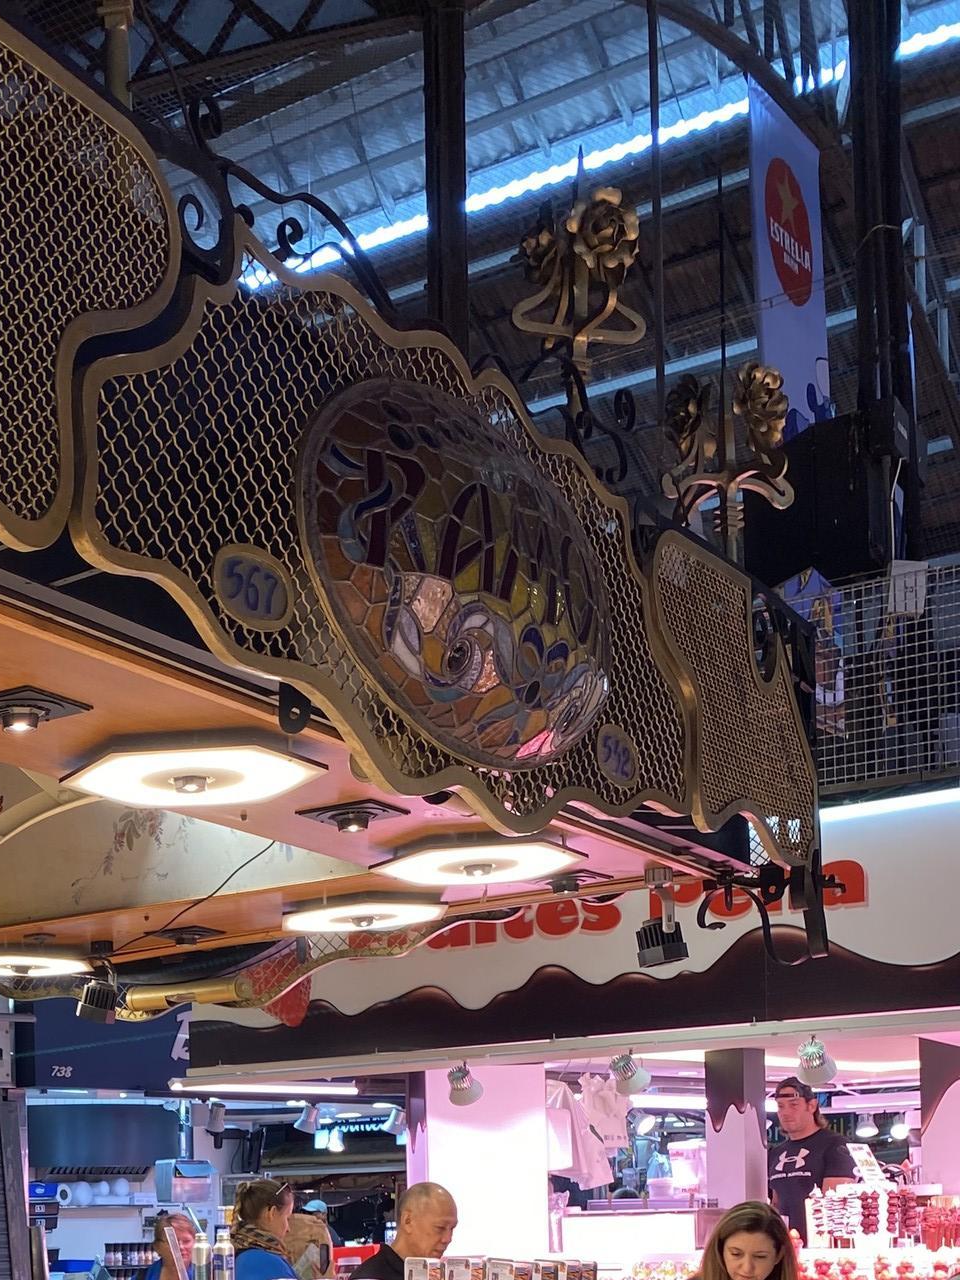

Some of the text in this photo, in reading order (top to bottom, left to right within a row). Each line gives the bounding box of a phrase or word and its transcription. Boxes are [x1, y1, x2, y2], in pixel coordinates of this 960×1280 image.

[769, 216, 811, 272] ESTRELLA
[223, 559, 278, 614] 567
[603, 735, 630, 779] 542
[50, 1065, 73, 1078] 738
